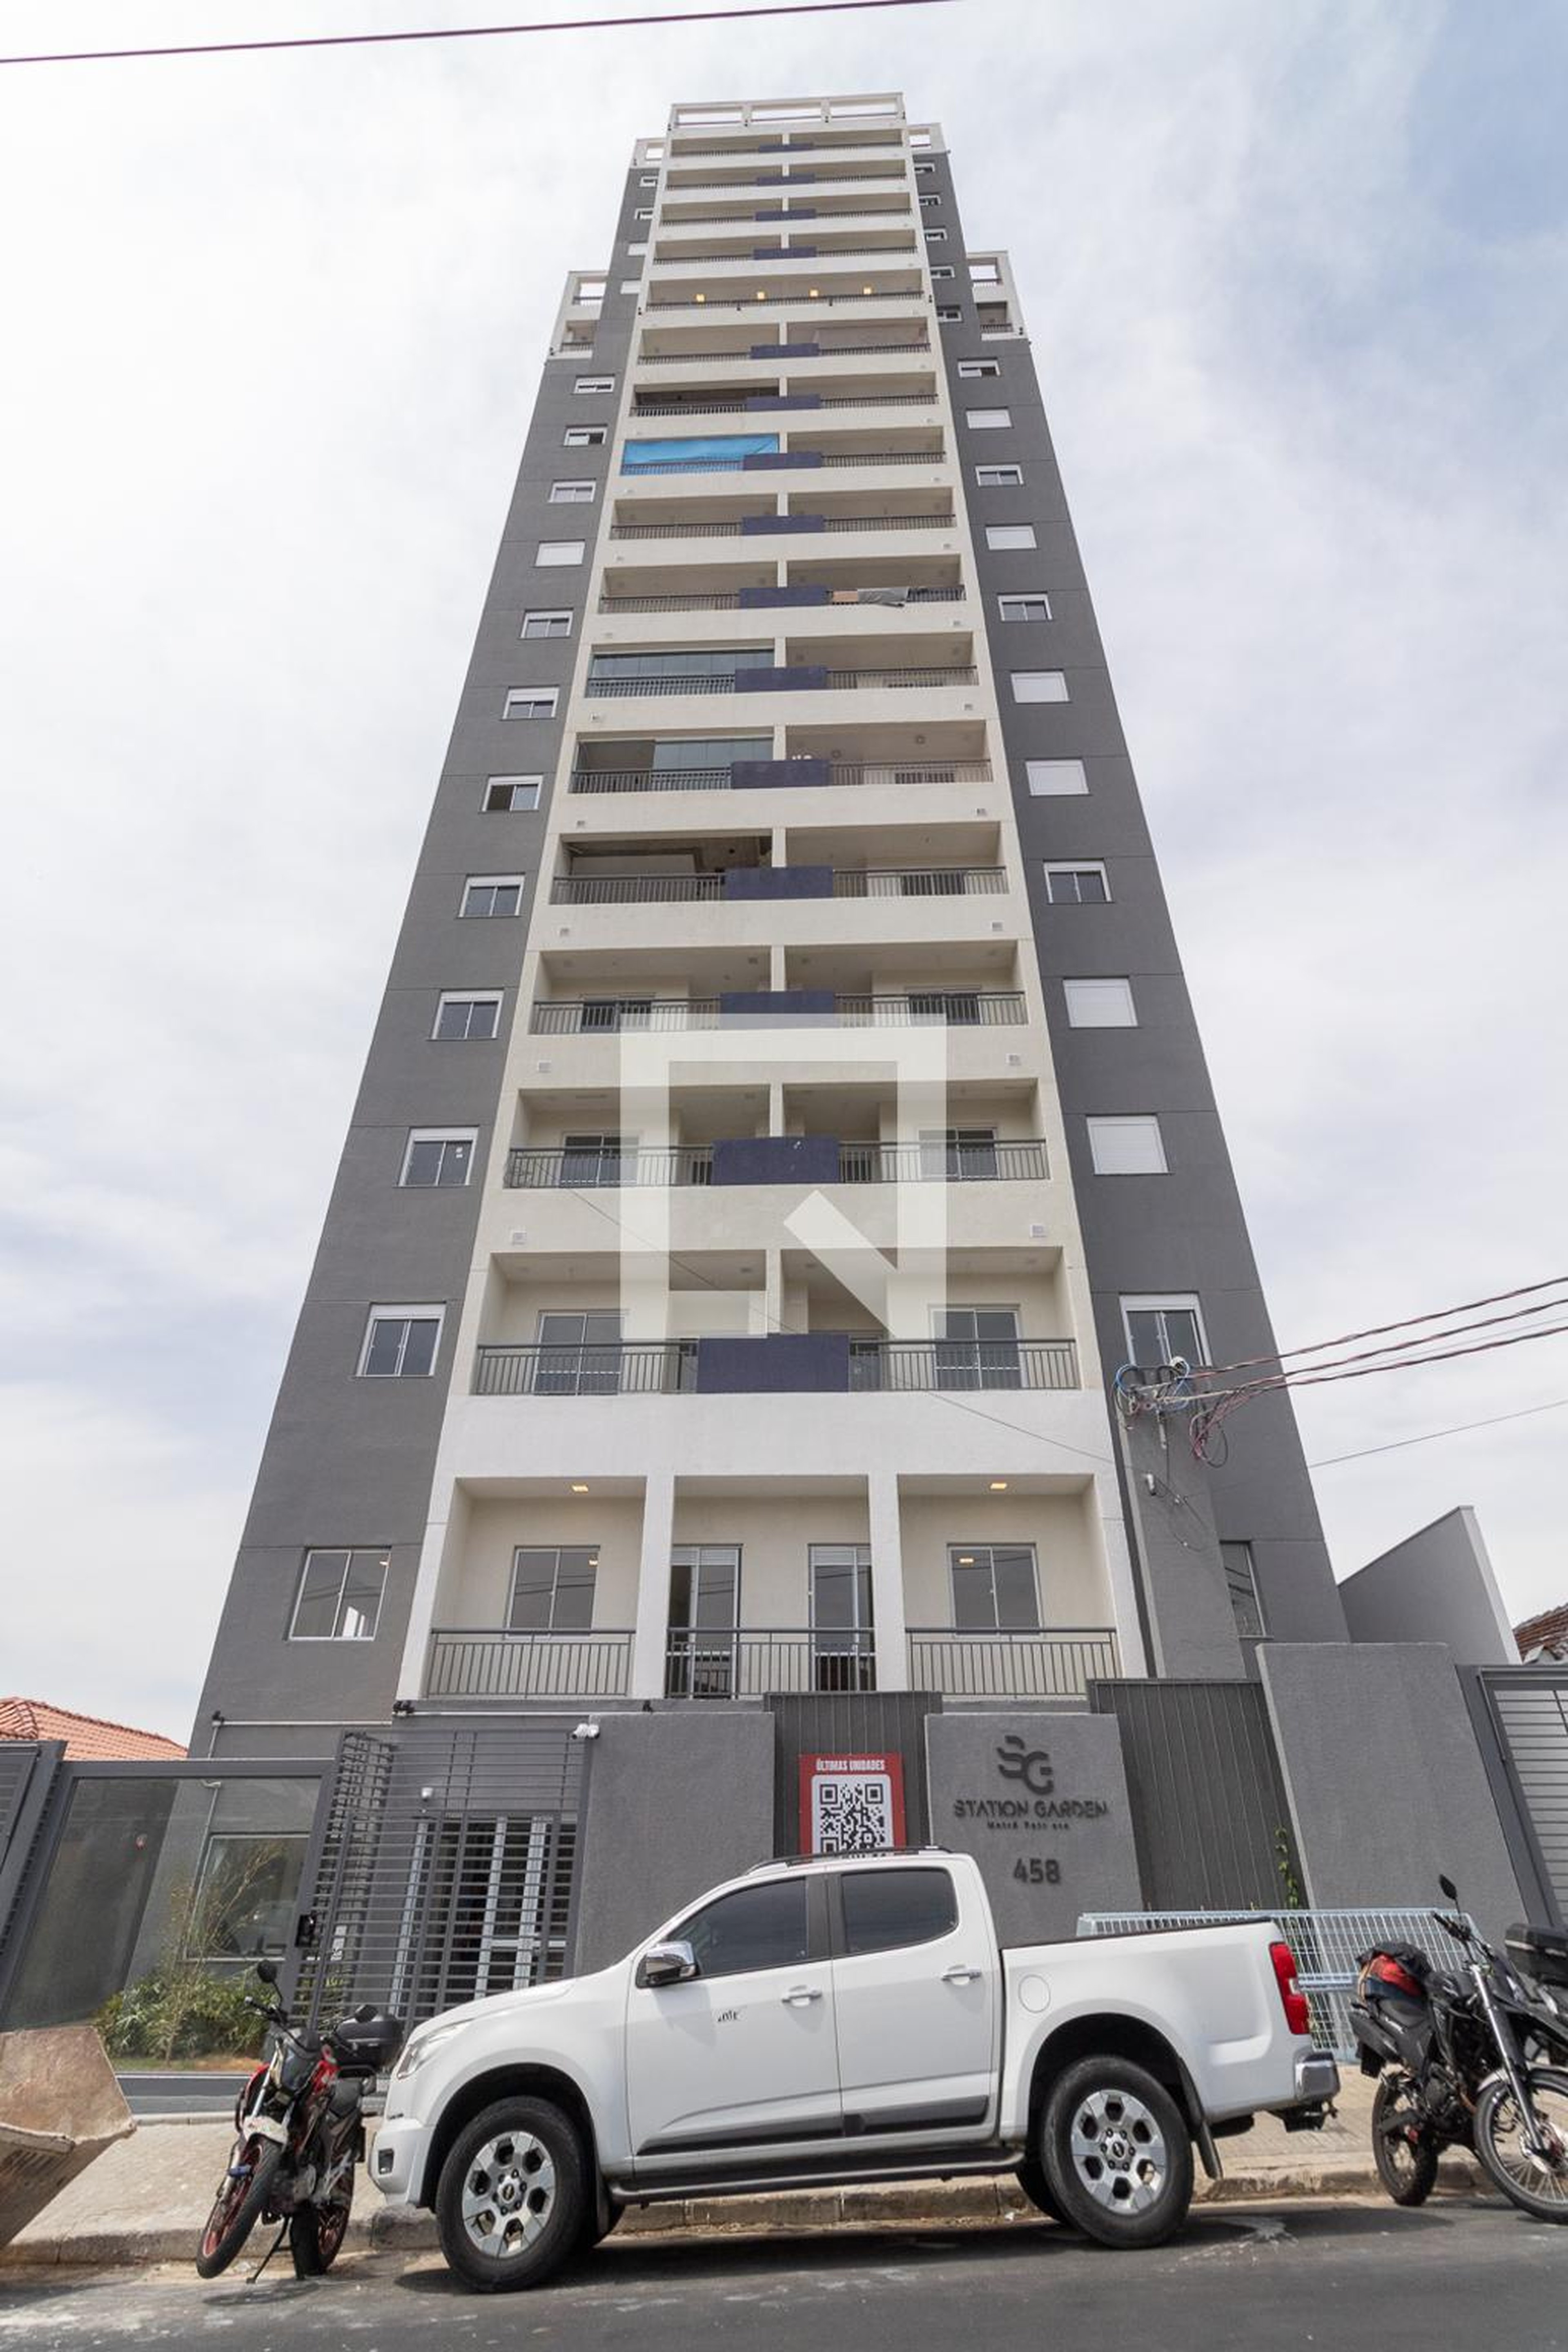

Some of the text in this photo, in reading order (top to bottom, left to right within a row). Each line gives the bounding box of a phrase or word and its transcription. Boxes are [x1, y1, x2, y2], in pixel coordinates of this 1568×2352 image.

[953, 1800, 1108, 1818] STATION GARDEN
[1014, 1858, 1061, 1883] 458
